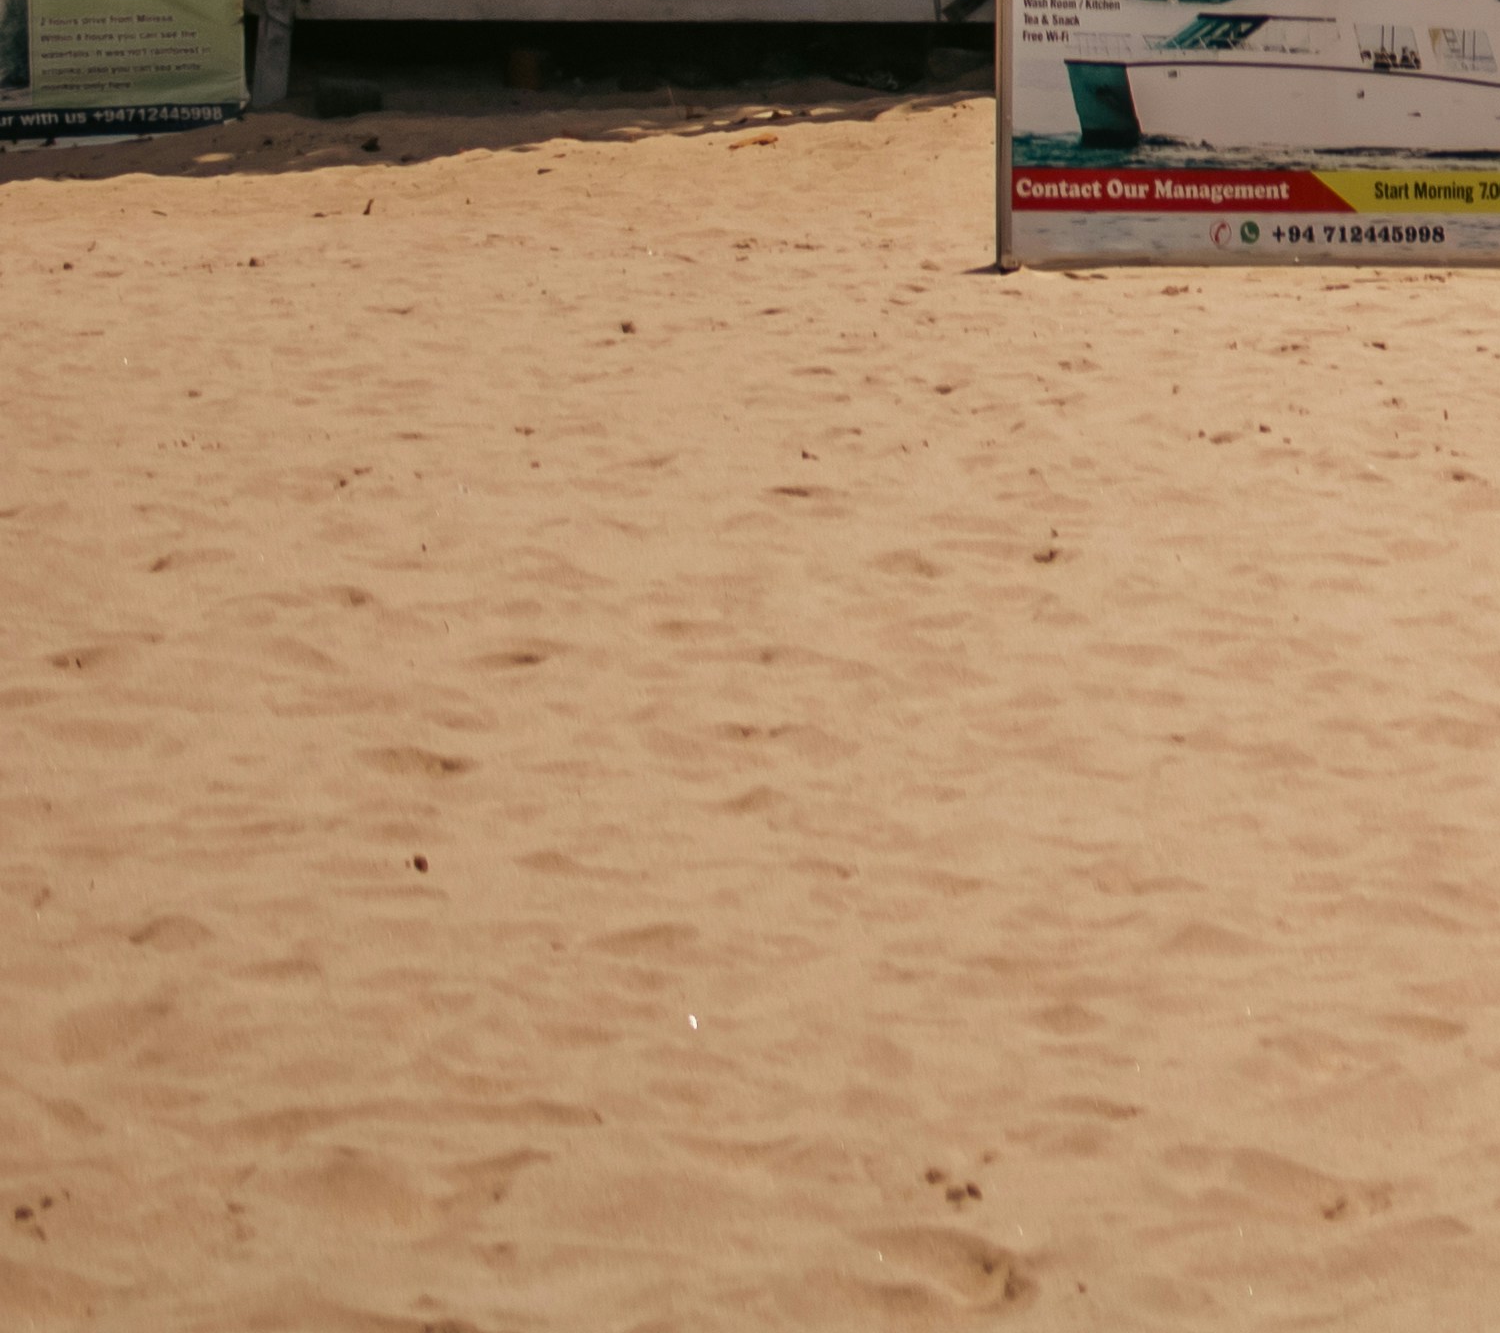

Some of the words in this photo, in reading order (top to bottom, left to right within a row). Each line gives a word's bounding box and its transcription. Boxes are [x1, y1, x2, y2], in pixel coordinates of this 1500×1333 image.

[1024, 14, 1038, 24] Tea
[1042, 15, 1049, 25] &
[1052, 15, 1080, 25] Snack
[20, 112, 59, 126] with
[65, 112, 86, 124] us
[93, 106, 223, 123] +94712445998
[1016, 178, 1102, 198] Contact
[1107, 179, 1149, 199] Our
[1155, 180, 1289, 203] Management
[1374, 181, 1409, 199] Start
[1414, 182, 1474, 203] Morning
[1272, 225, 1315, 242] +94
[1324, 226, 1445, 243] 712445998
